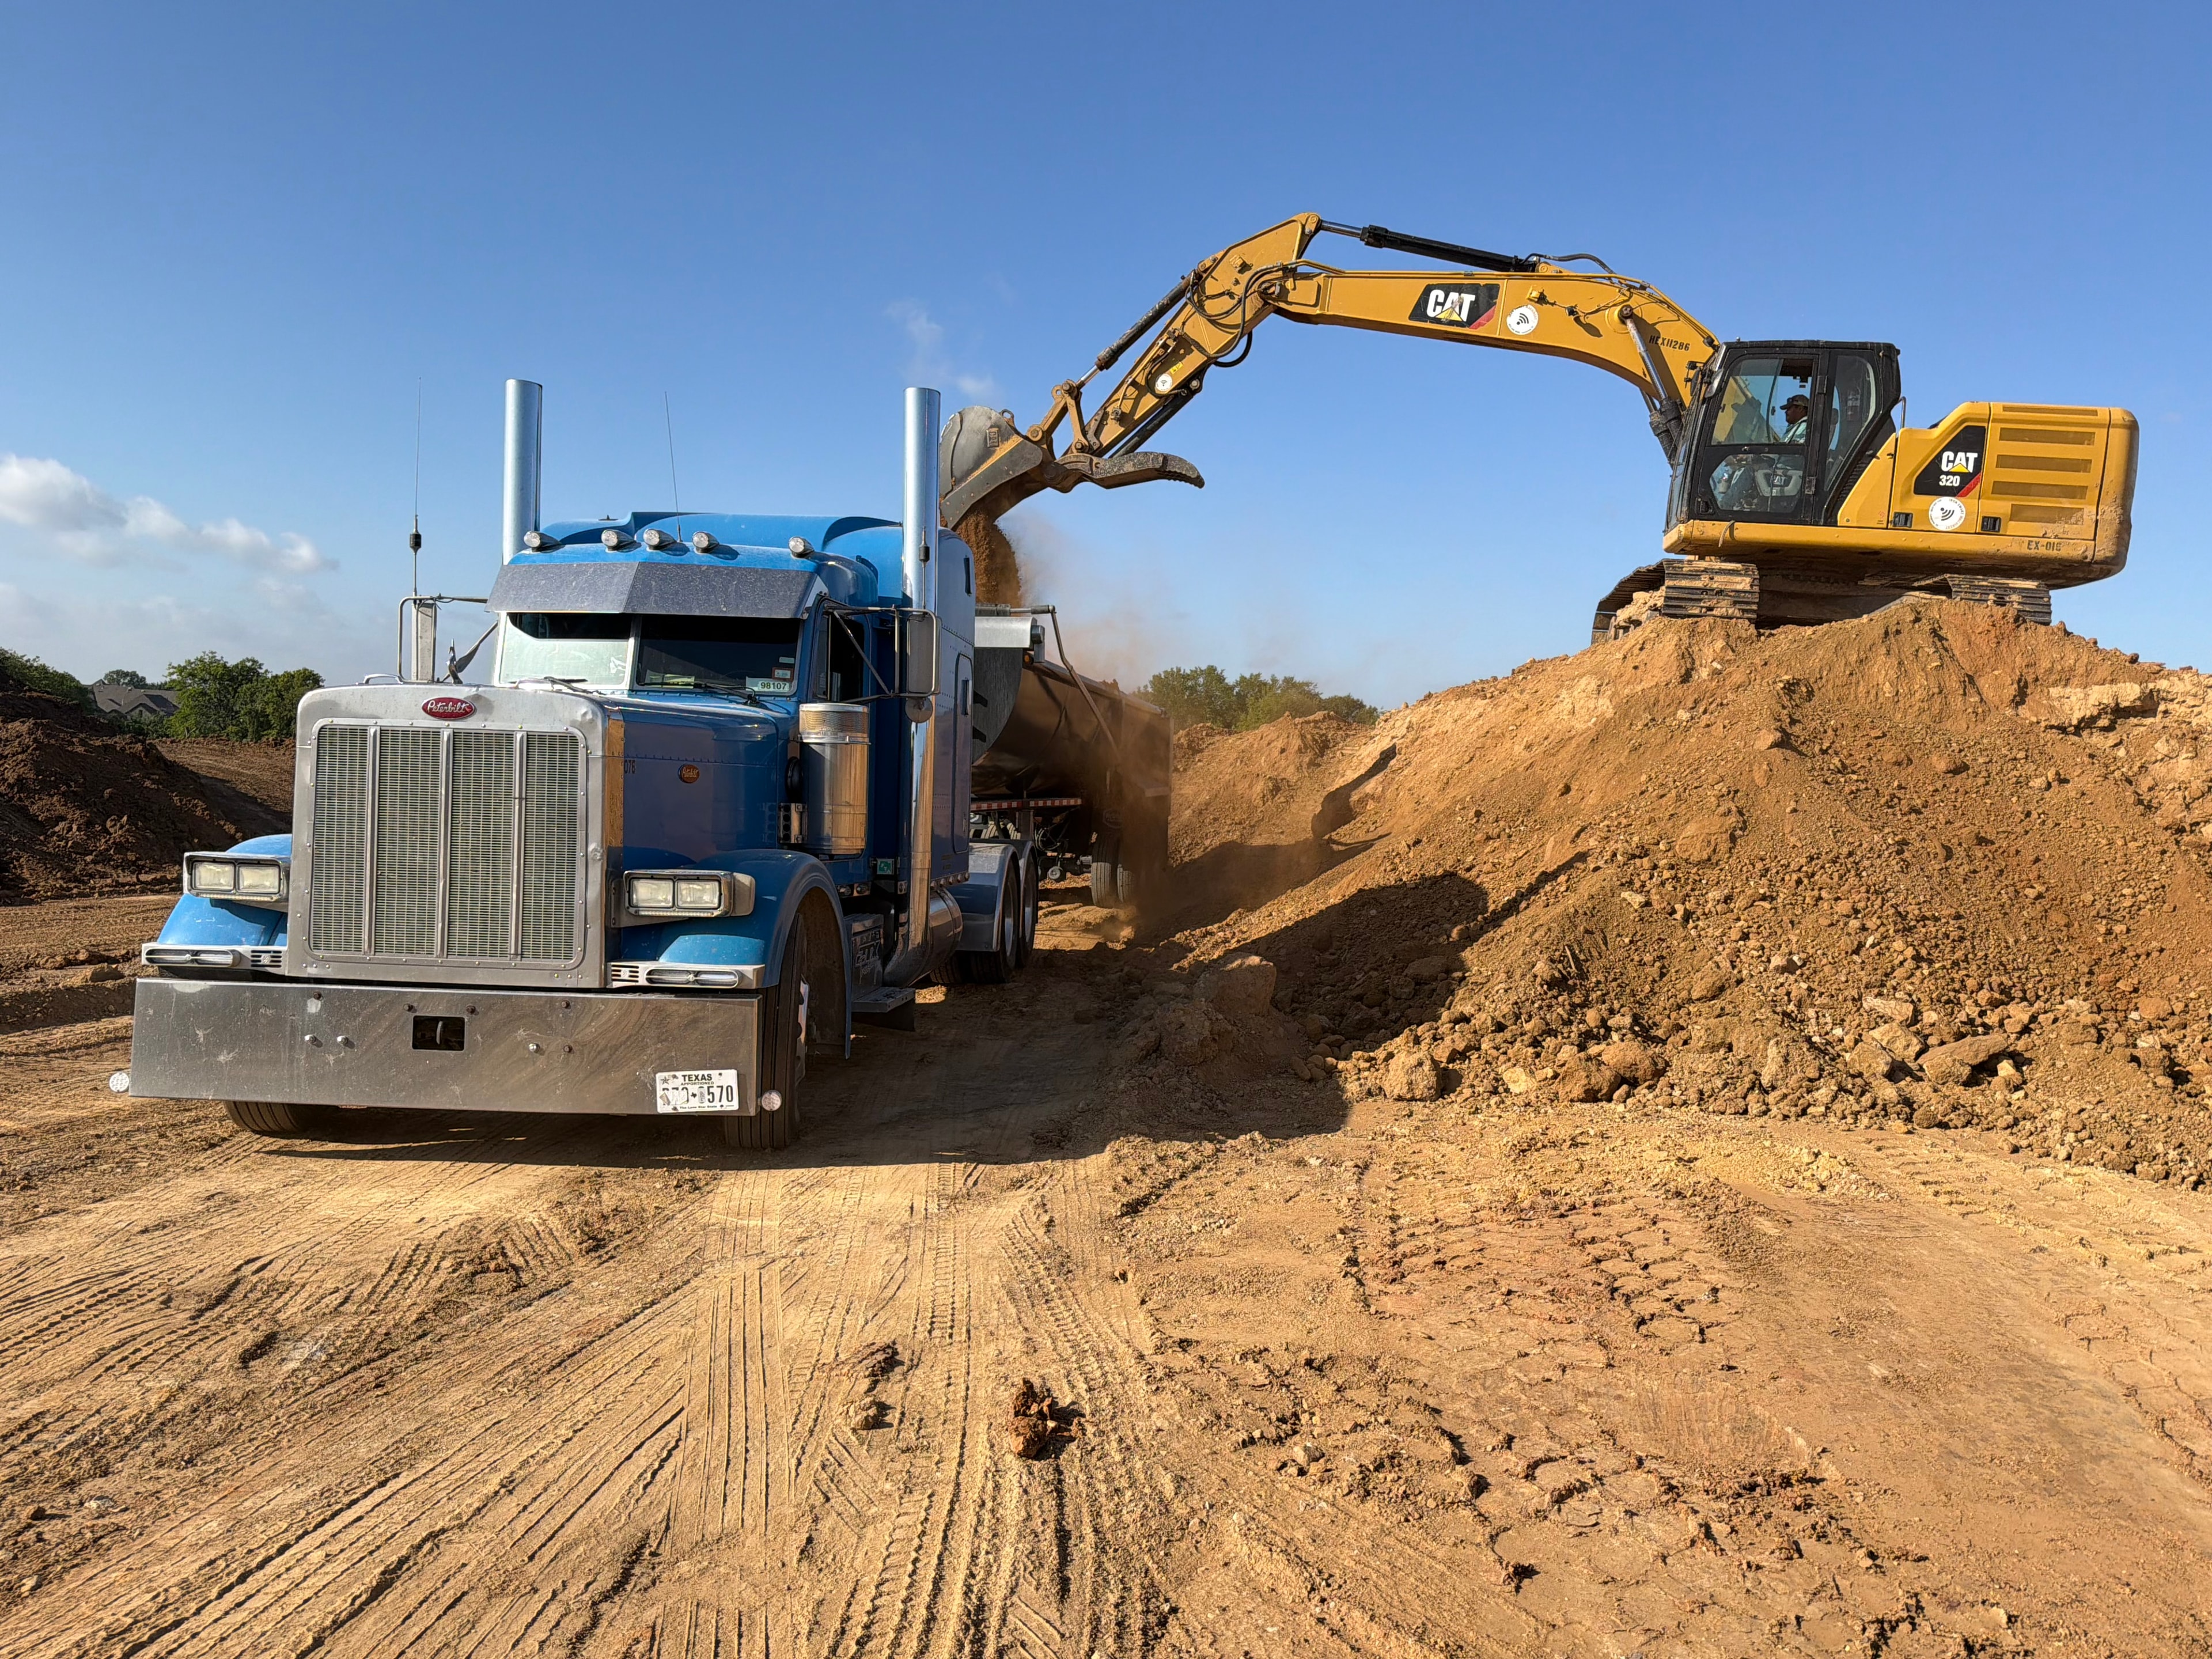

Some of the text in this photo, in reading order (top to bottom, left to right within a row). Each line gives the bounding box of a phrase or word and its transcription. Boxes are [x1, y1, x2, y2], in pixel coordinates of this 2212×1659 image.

[1426, 289, 1475, 322] CAT
[1941, 451, 1978, 473] CAT
[1939, 475, 1960, 487] 320
[760, 681, 787, 690] 98107
[427, 700, 469, 713] Peterbilt
[681, 1073, 713, 1082] TEXAS
